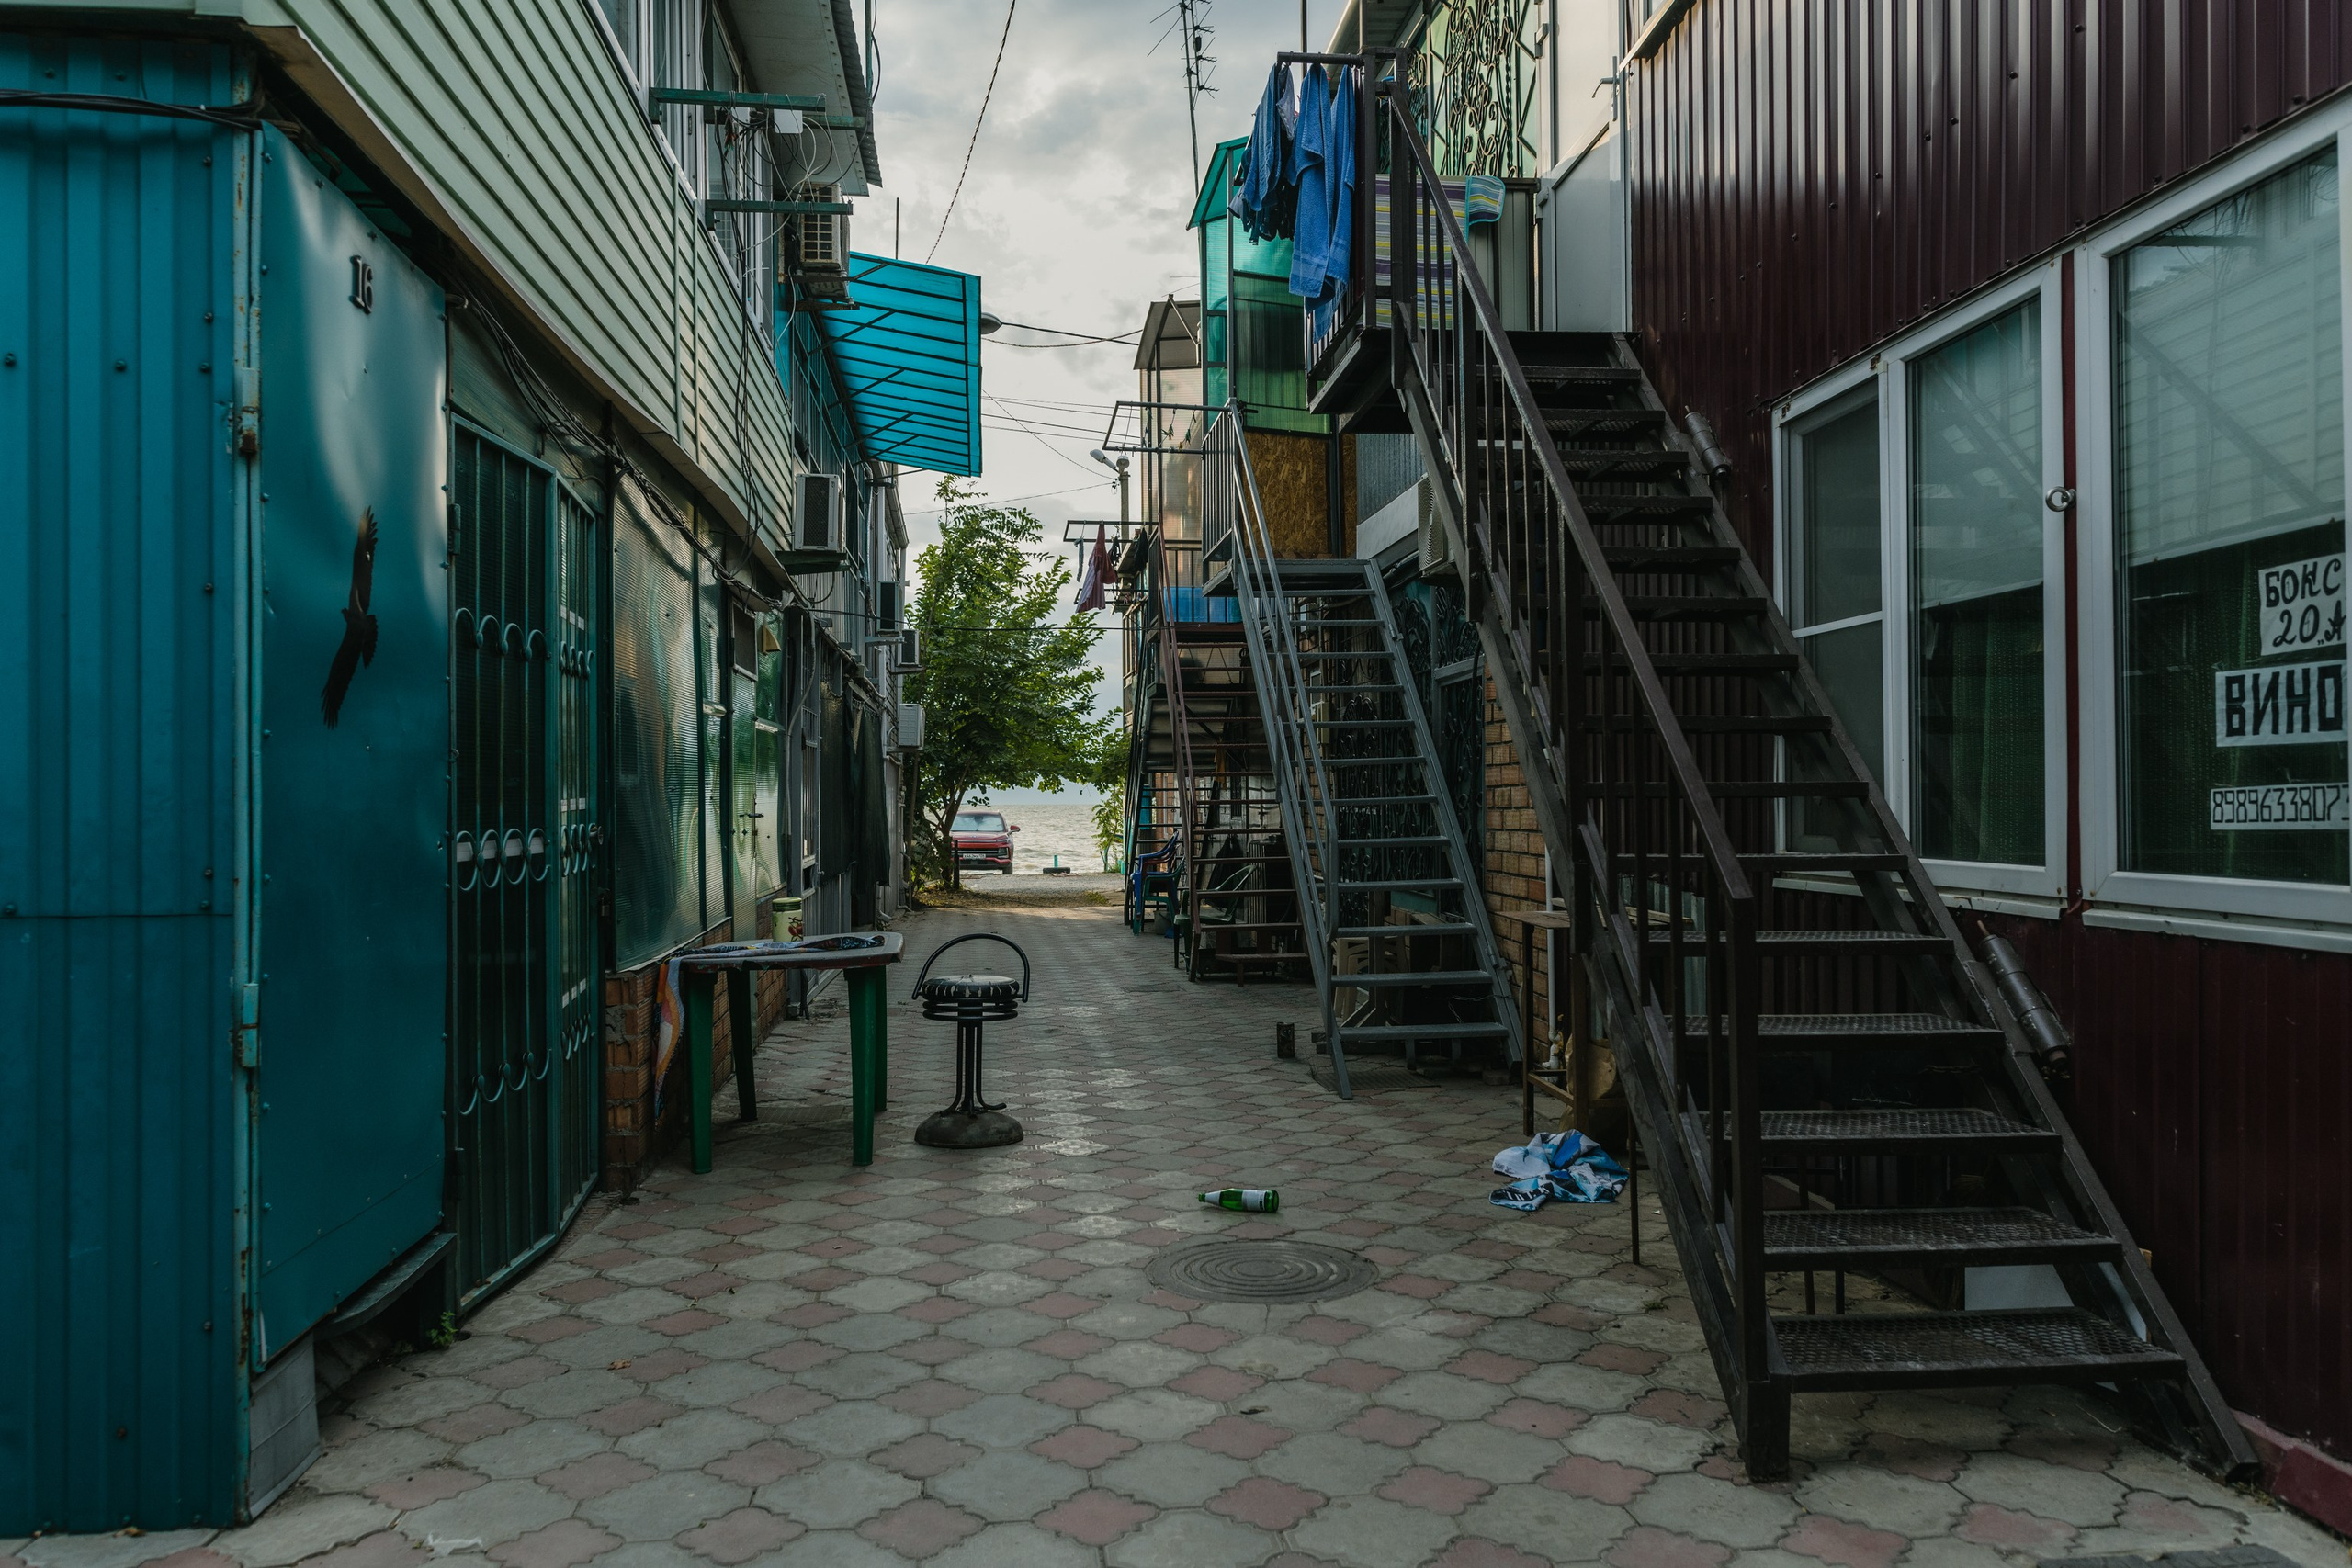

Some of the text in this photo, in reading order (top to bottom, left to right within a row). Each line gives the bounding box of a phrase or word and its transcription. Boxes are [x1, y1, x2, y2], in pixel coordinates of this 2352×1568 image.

[348, 254, 373, 316] 16
[2265, 558, 2342, 608] БОКС
[2225, 664, 2343, 737] ВИНО
